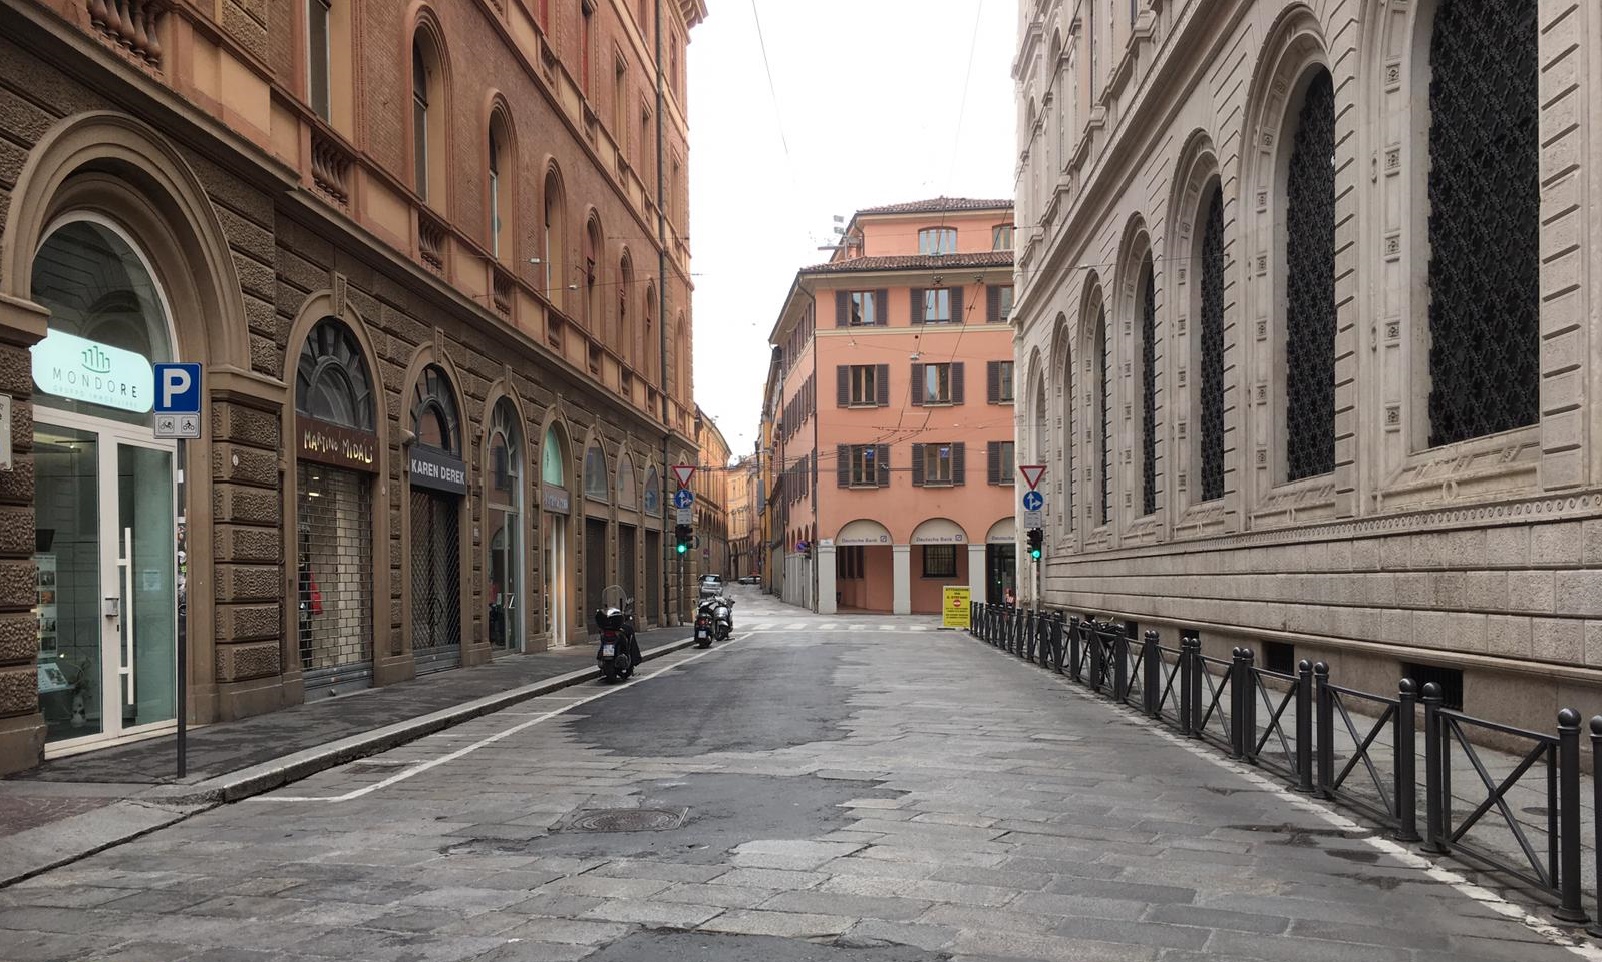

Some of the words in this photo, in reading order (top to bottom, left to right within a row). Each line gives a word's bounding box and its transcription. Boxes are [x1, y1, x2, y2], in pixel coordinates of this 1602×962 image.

[52, 367, 137, 398] MONDORE
[163, 368, 192, 408] P
[411, 458, 439, 478] KAREN
[440, 466, 465, 485] DEREK
